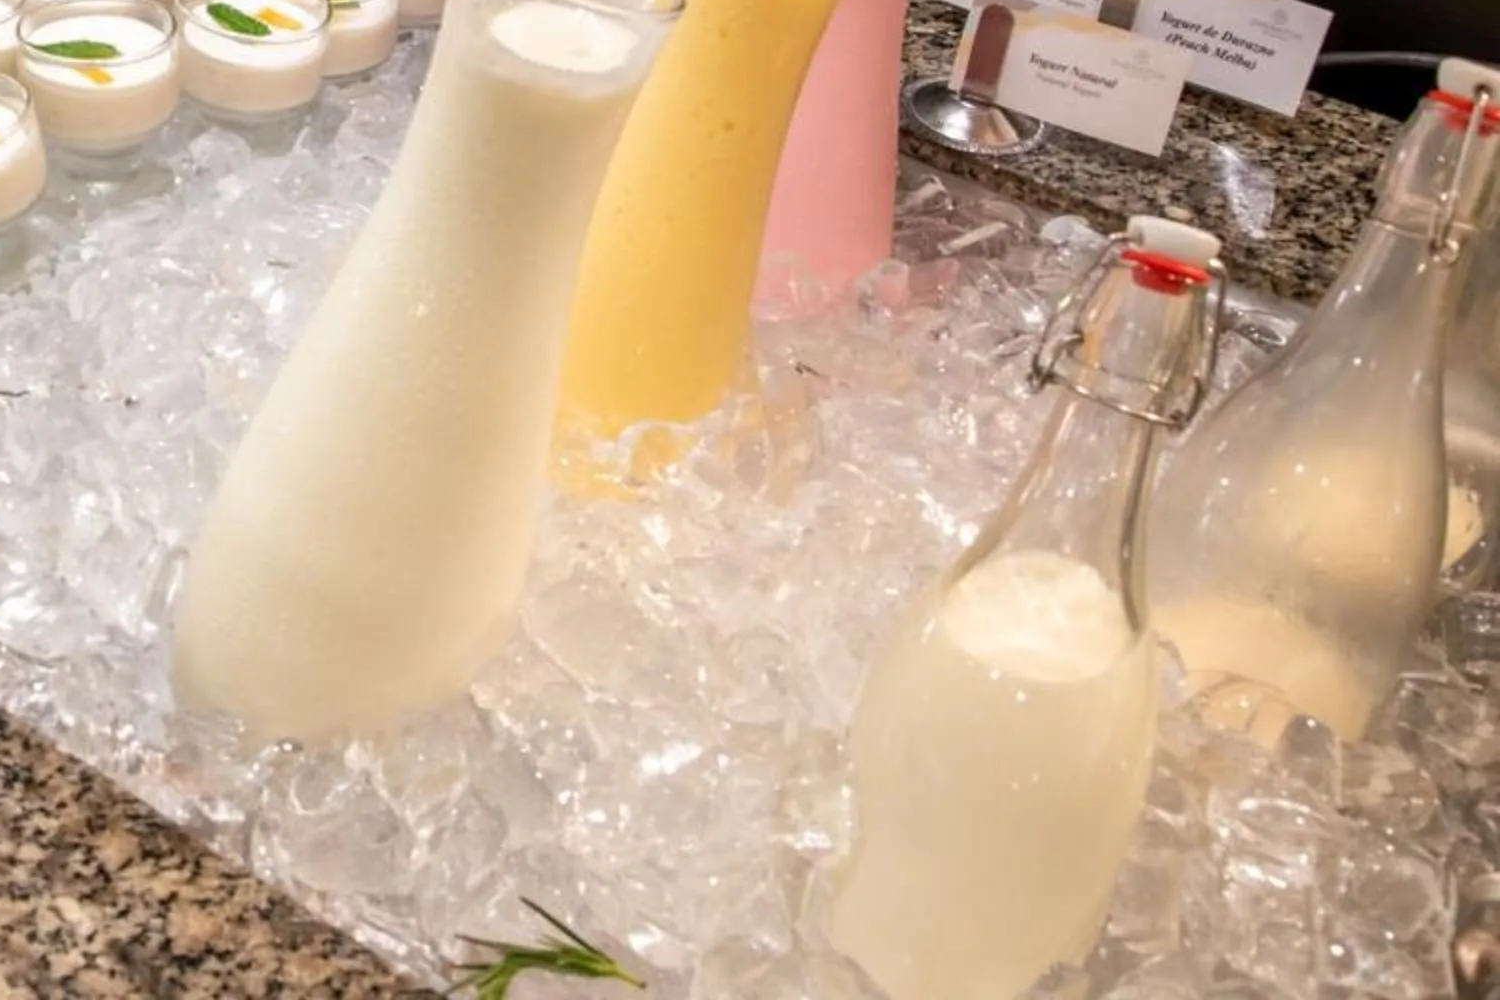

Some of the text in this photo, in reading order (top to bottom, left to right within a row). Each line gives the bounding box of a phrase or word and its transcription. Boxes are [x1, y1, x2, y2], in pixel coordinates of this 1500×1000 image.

[1164, 33, 1210, 55] (Peach
[1203, 25, 1219, 39] de
[1221, 31, 1276, 57] Durazno
[1071, 65, 1118, 89] Natural
